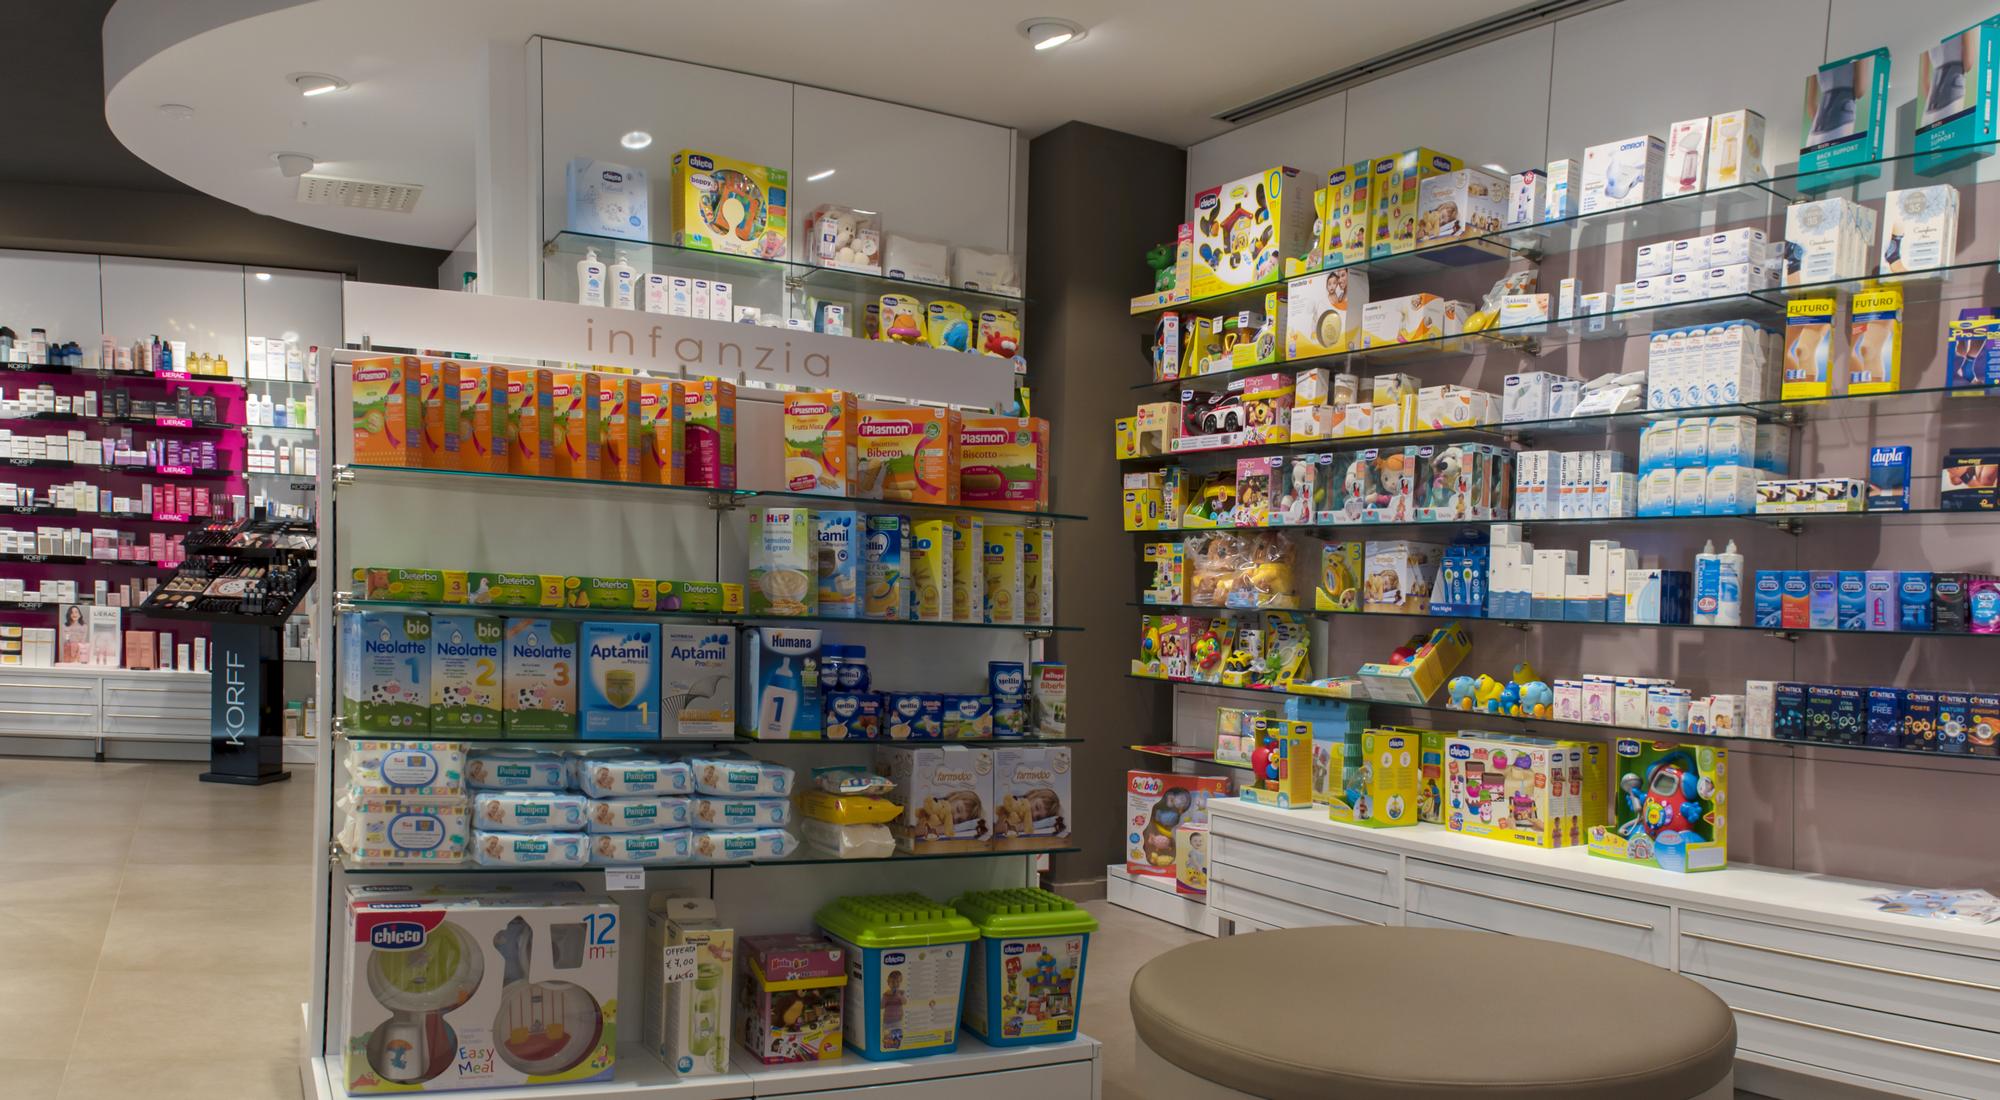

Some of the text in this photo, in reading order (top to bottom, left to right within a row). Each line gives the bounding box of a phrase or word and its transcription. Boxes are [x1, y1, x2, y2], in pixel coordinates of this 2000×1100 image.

[690, 157, 713, 170] chicco
[1789, 303, 1830, 313] FUTURO
[1855, 297, 1893, 309] FUTURO
[586, 318, 831, 378] infanzia
[163, 419, 186, 427] LIERAC
[866, 423, 909, 436] Plasmon
[961, 433, 1005, 445] Plasmon
[866, 448, 904, 459] Biberon
[962, 450, 998, 460] Biscotto
[1872, 449, 1903, 467] dupla
[818, 529, 849, 542] tamil
[400, 569, 438, 582] Dieterba
[498, 575, 535, 586] Dieterba
[452, 581, 461, 590] 3
[549, 585, 558, 595] 3
[592, 578, 629, 590] Dieterba
[683, 583, 718, 594] Dieterba
[641, 589, 650, 598] 3
[730, 593, 738, 602] 3
[406, 620, 429, 634] bio
[478, 623, 500, 637] bio
[365, 640, 426, 654] Neolatte
[772, 635, 812, 649] Humana
[437, 643, 498, 657] Neolatte
[513, 645, 572, 659] Neolatte
[589, 643, 649, 661] Aptamil
[670, 645, 726, 661] Aptamil
[404, 656, 420, 684] 1
[475, 657, 497, 686] 2
[553, 661, 570, 686] 3
[226, 650, 245, 746] KORFF
[638, 702, 649, 726] 1
[773, 697, 785, 721] 1
[500, 766, 529, 776] Pampers
[626, 771, 655, 782] Pampers
[517, 805, 547, 815] Pampers
[626, 806, 655, 816] Pampers
[726, 806, 755, 815] Pampers
[516, 841, 546, 851] Pampers
[374, 926, 421, 945] chicco
[583, 913, 616, 945] 12
[460, 1046, 495, 1063] Easy
[458, 1063, 494, 1076] Meal
